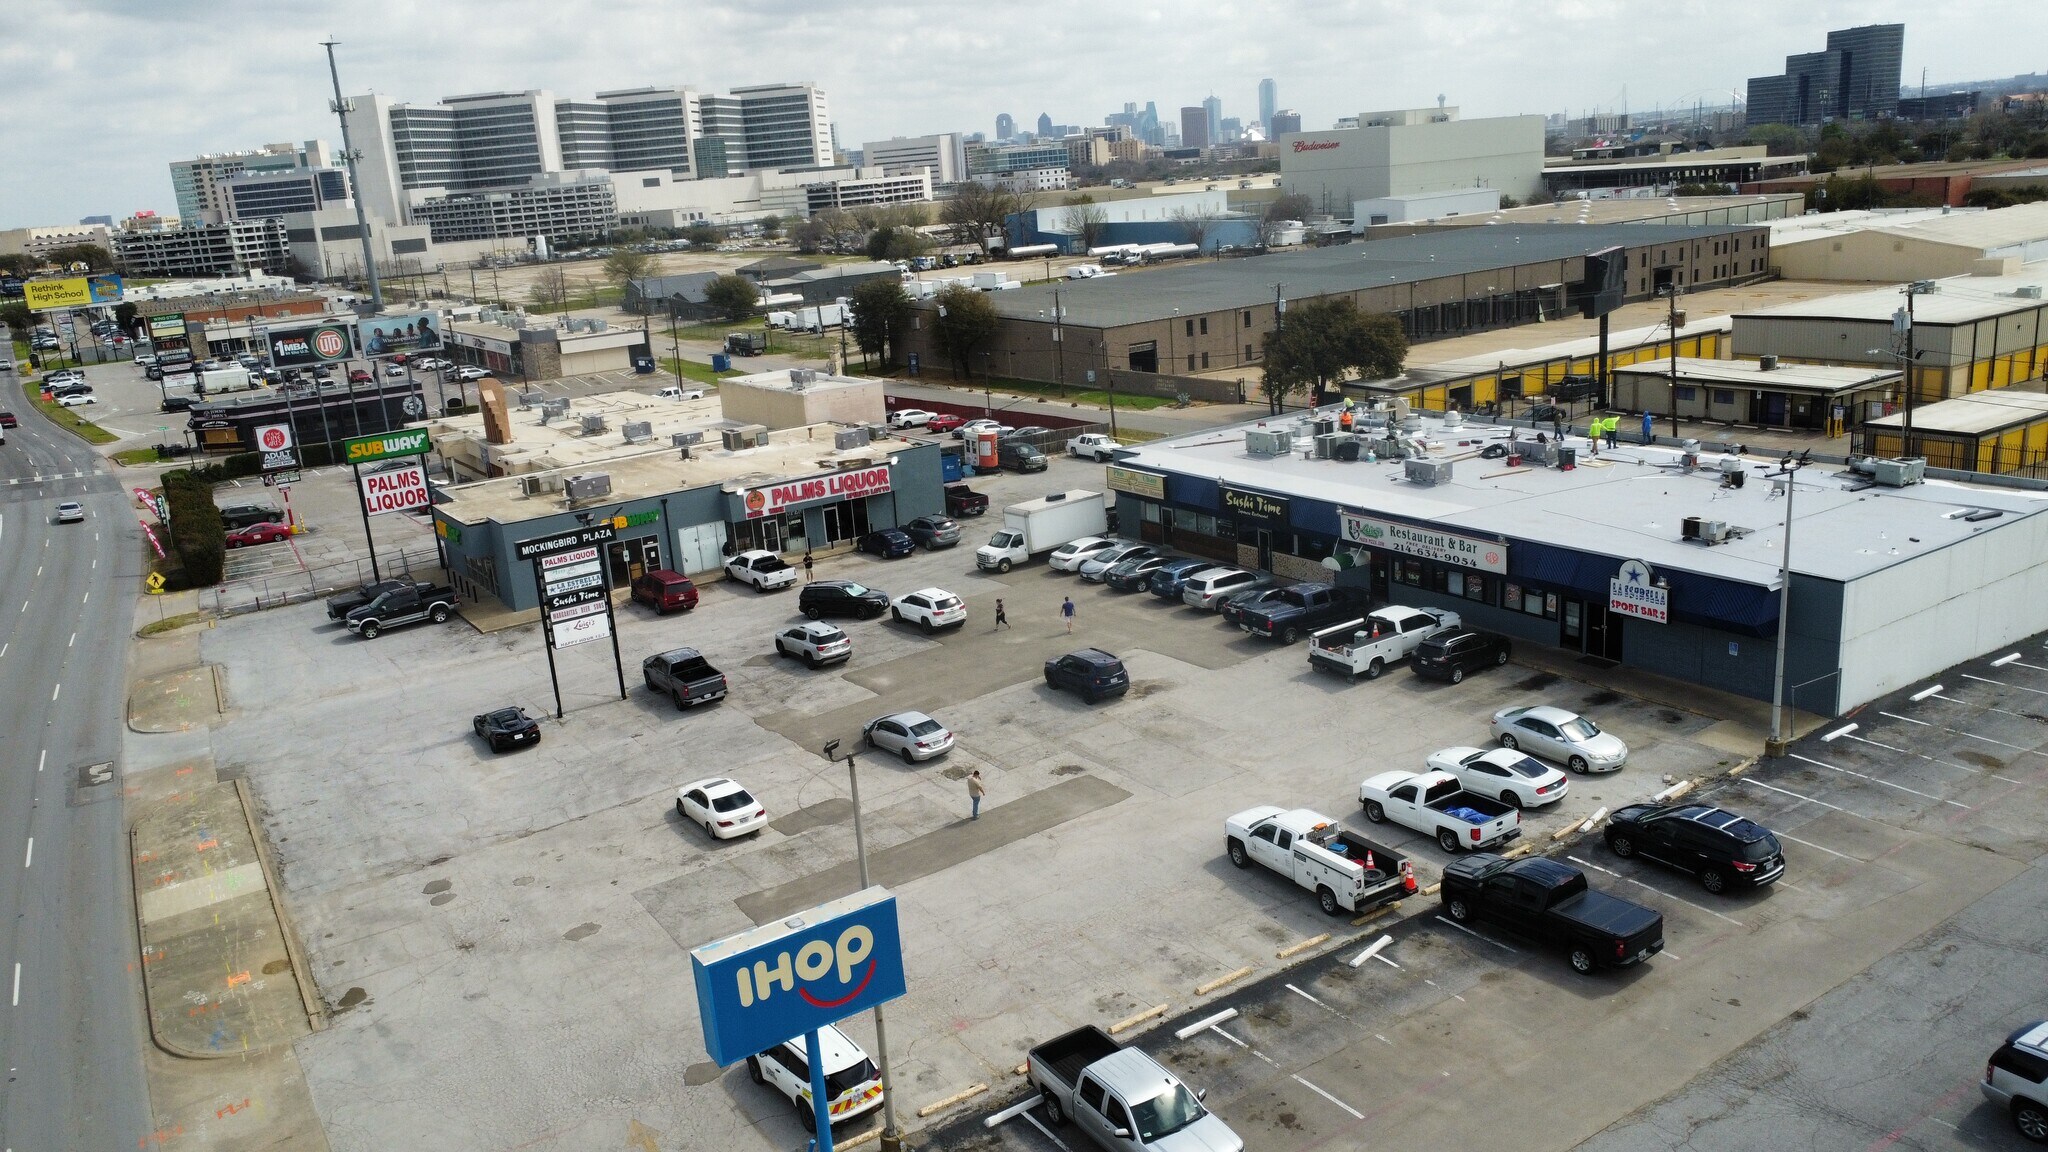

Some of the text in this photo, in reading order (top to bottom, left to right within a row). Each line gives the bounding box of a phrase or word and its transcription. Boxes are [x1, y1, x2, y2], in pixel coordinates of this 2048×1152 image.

[1292, 140, 1341, 153] Budweiser
[31, 283, 65, 293] Rethink
[33, 292, 54, 302] High
[54, 290, 84, 300] School
[284, 342, 309, 352] MBA
[320, 334, 341, 353] UTD
[349, 433, 426, 459] SUBWAY
[264, 450, 291, 460] ADULT
[367, 470, 421, 494] PALMS
[771, 468, 889, 506] PALMS LIQUOR
[870, 485, 890, 495] LOTTO
[366, 487, 428, 513] LIQUOR
[1225, 491, 1281, 516] Sushi Time
[522, 529, 612, 556] MOCKINGBIRD PLAZA
[1389, 525, 1478, 554] Restaurant & Bar
[1393, 543, 1477, 567] 214-634-9054
[1421, 544, 1447, 553] DELIVERY
[544, 549, 596, 567] PALMS LIQUOR
[567, 575, 601, 587] ESTRELLA
[1612, 582, 1623, 597] LA
[553, 591, 600, 608] Sushi Time
[1611, 599, 1666, 621] SPORT BAR 2
[574, 619, 596, 631] Luigi's
